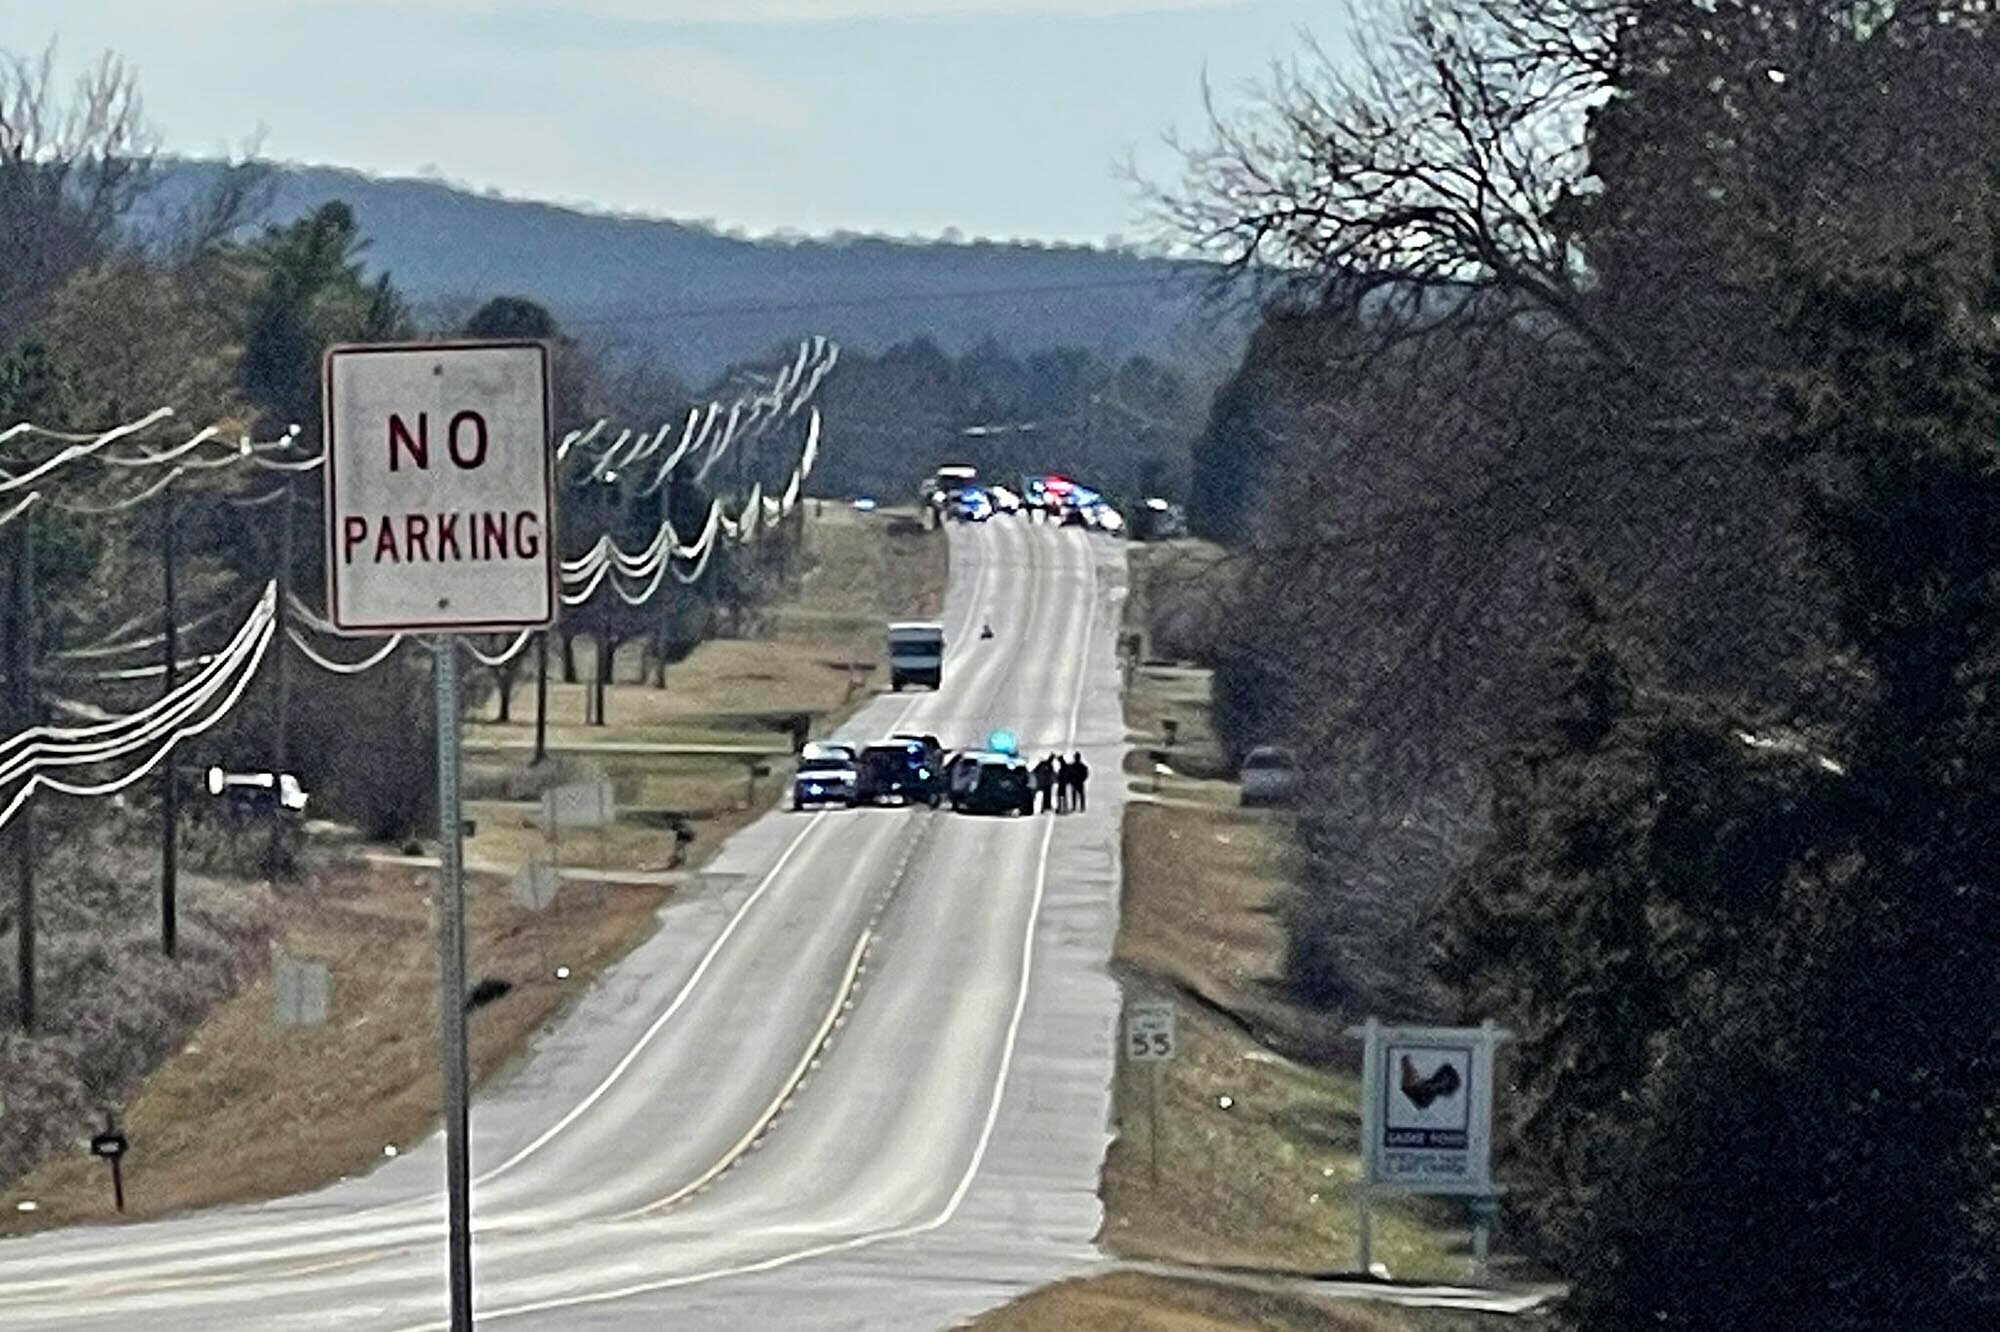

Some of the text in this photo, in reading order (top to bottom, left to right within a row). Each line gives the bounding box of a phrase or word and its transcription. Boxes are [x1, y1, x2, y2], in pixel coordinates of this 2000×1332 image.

[389, 409, 488, 472] NO
[344, 510, 540, 564] PARKING
[1132, 1033, 1171, 1057] 55
